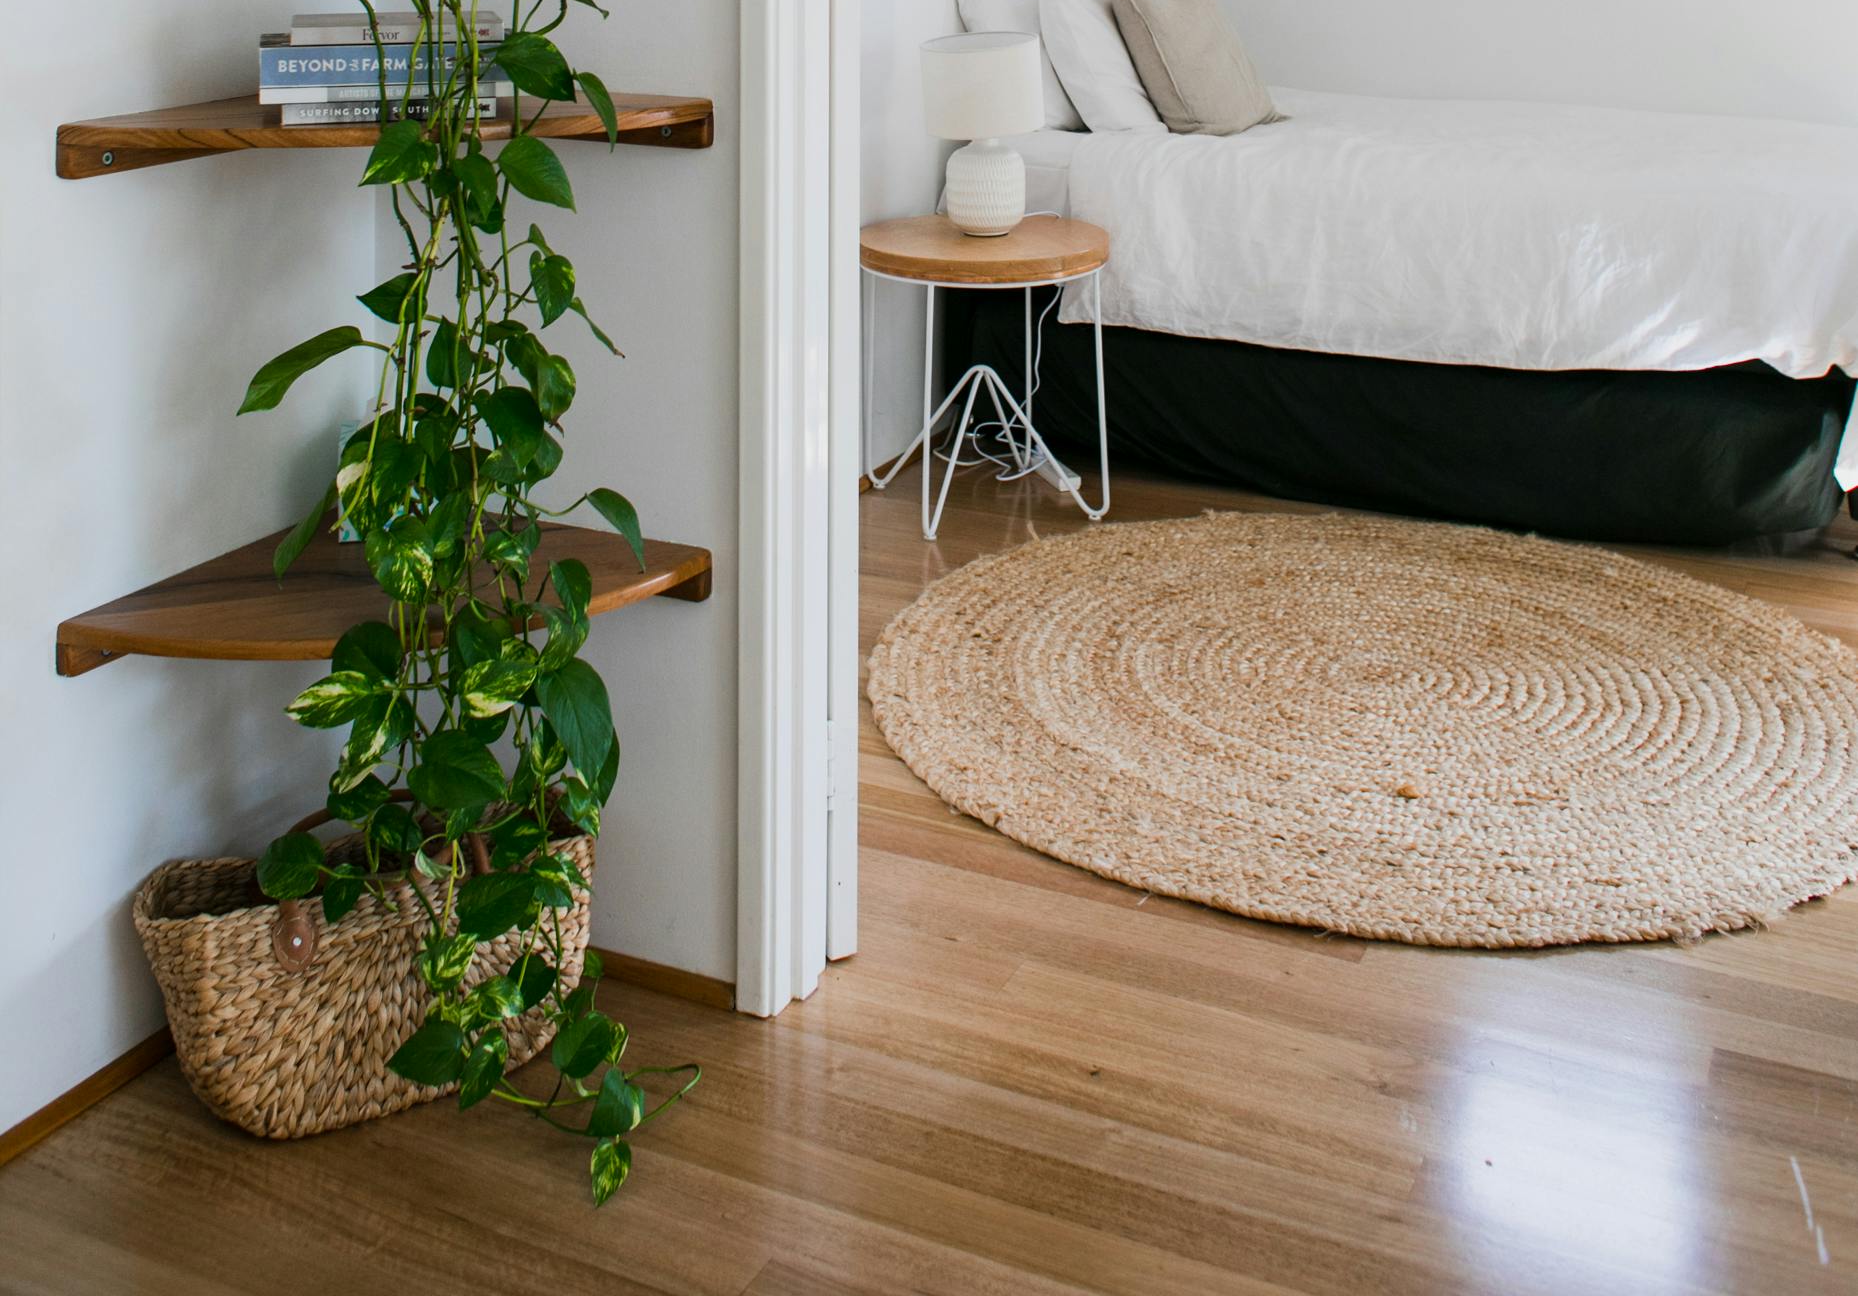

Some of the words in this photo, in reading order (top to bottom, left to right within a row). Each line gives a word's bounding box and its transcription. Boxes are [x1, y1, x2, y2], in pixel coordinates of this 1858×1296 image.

[362, 28, 400, 41] Fevor
[278, 58, 347, 73] BEYOND
[362, 58, 407, 72] FARM
[299, 106, 350, 117] SURFING
[353, 106, 381, 116] DOW
[392, 105, 430, 114] SUTH
